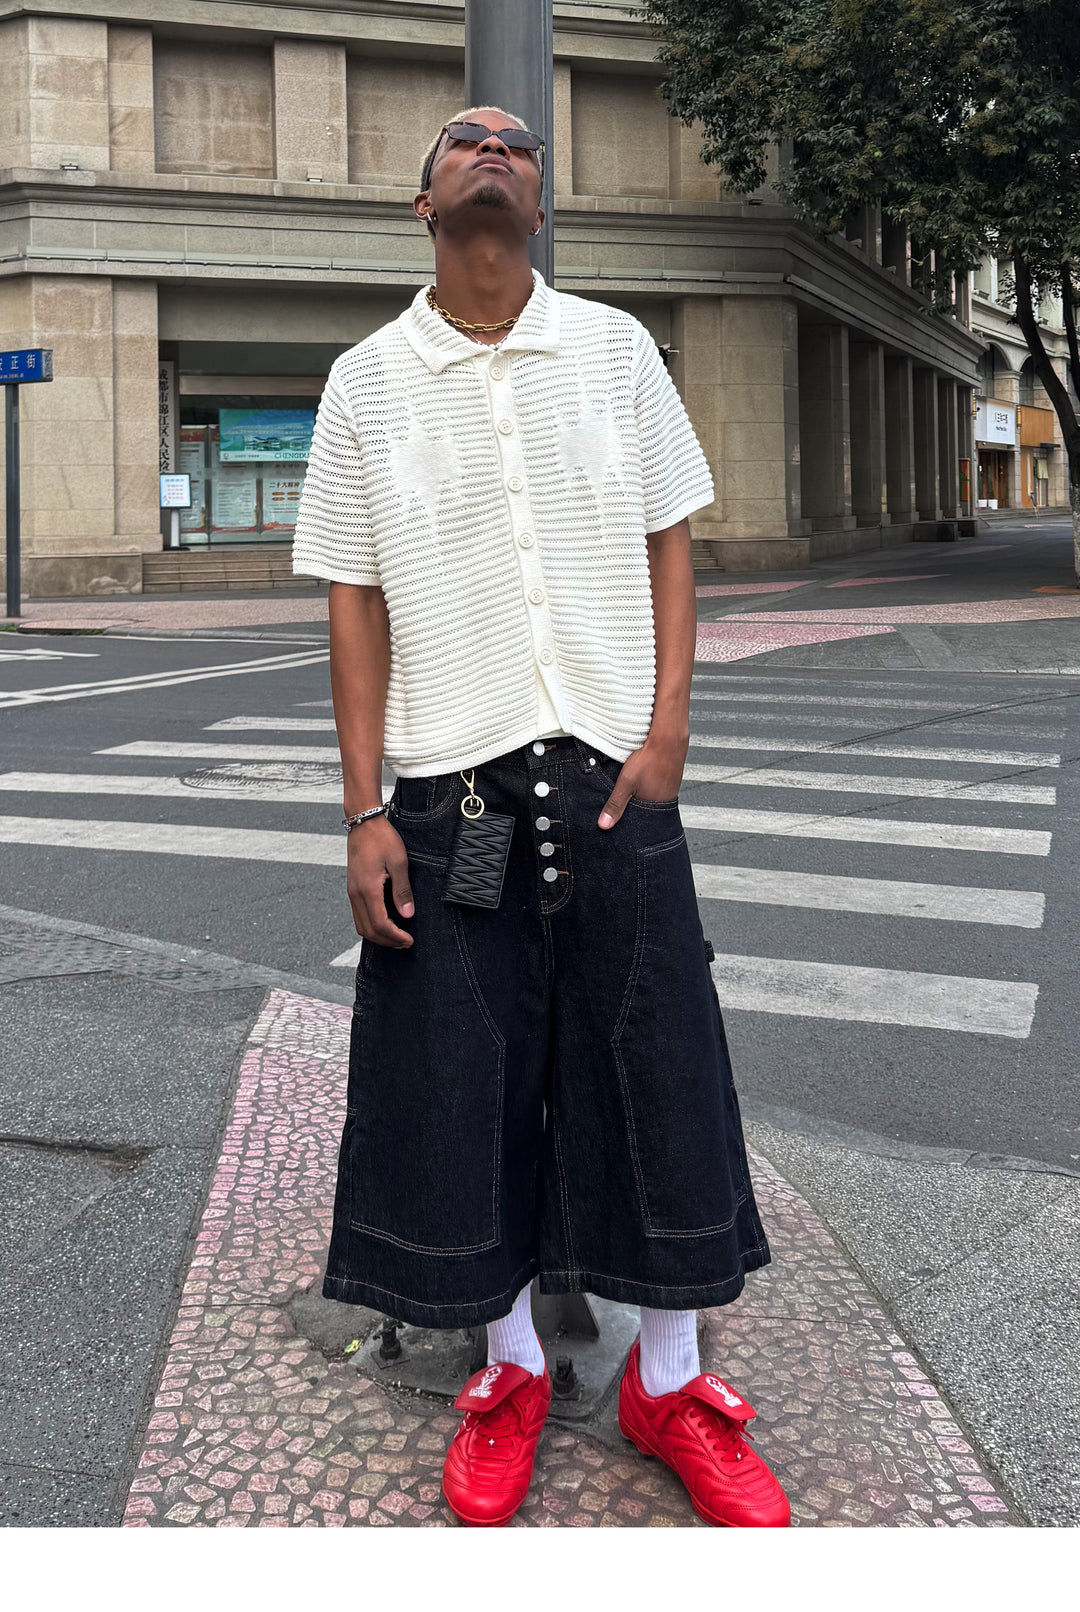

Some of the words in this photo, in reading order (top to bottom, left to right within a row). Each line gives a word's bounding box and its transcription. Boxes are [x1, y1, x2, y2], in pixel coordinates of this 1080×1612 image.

[0, 354, 36, 370] 正街
[159, 368, 170, 474] 成都市锦江区人民检
